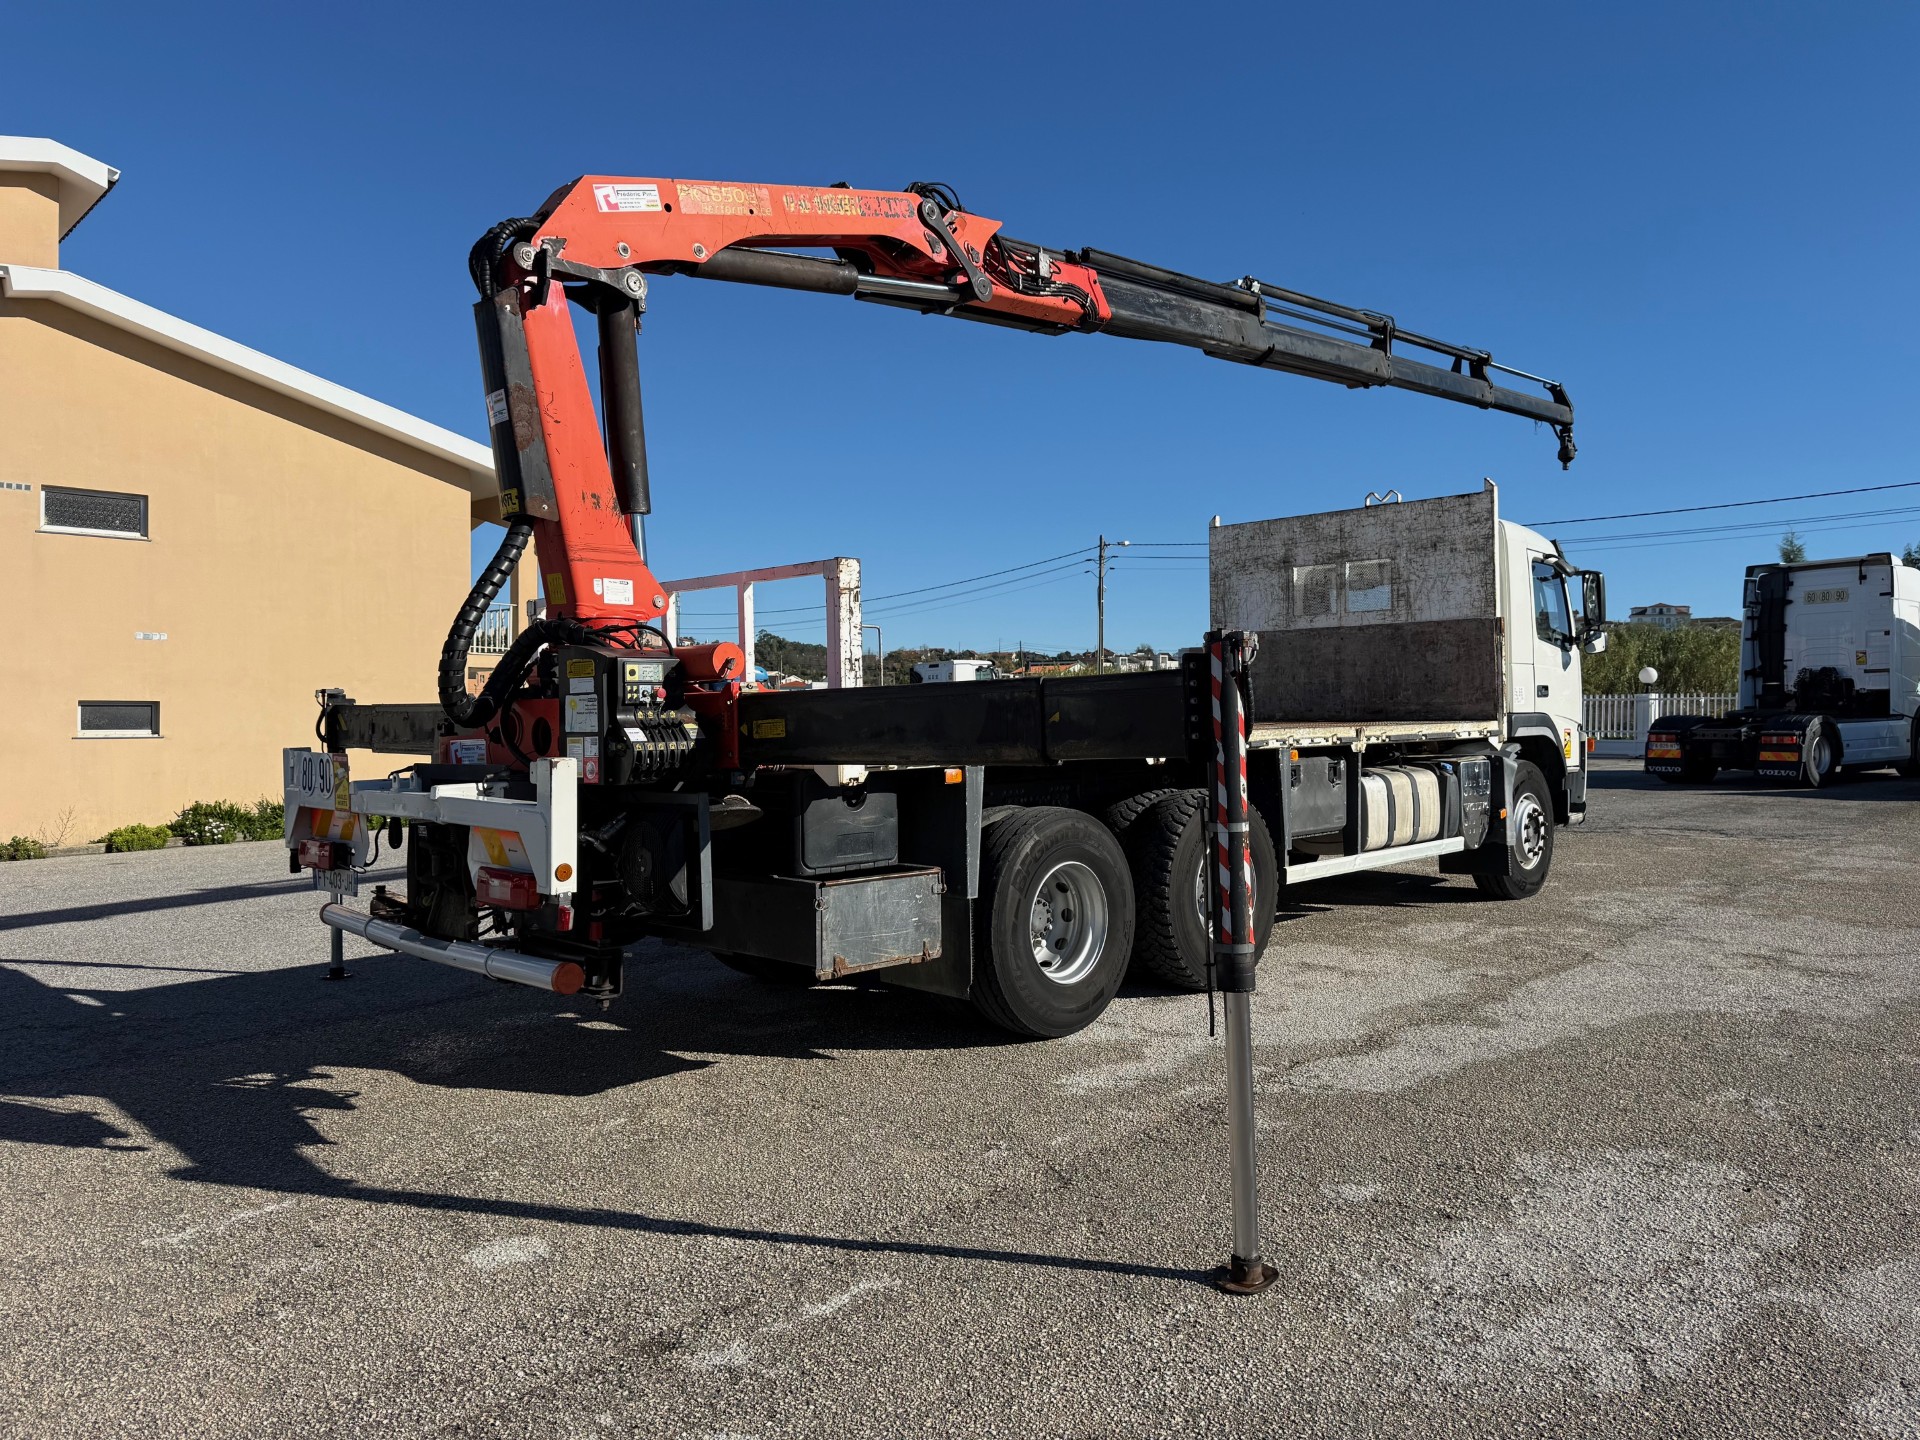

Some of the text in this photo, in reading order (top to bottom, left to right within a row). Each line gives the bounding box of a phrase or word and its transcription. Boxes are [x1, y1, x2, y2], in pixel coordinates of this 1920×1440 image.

[1821, 591, 1830, 601] 80
[302, 756, 331, 793] 80 90
